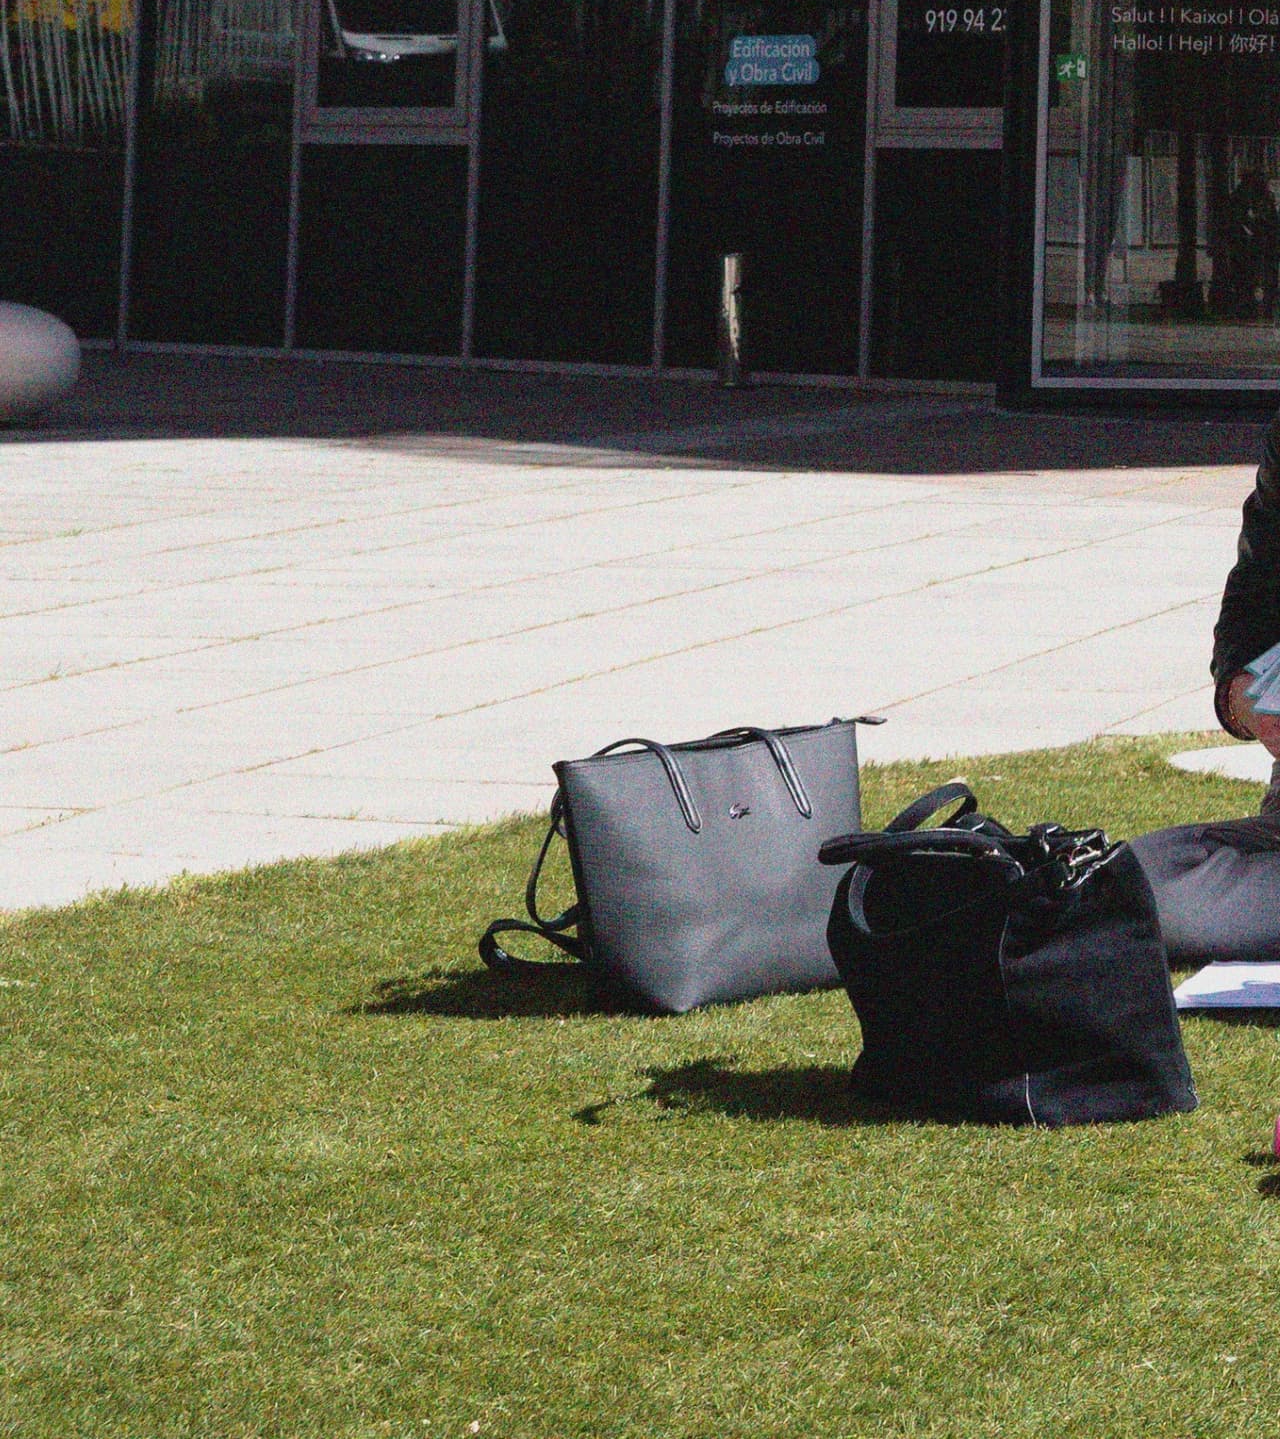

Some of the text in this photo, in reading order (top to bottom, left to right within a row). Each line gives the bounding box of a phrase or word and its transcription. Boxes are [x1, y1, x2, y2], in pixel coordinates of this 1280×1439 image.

[925, 9, 957, 32] 919
[963, 8, 985, 31] 94
[1112, 7, 1154, 23] Salut
[1181, 9, 1233, 24] Kaixo!
[733, 39, 810, 58] Edificación
[1113, 35, 1212, 55] Hallo! Hej!
[730, 62, 812, 86] y Obra Civil
[713, 131, 825, 147] Proyectos de Obra Civil
